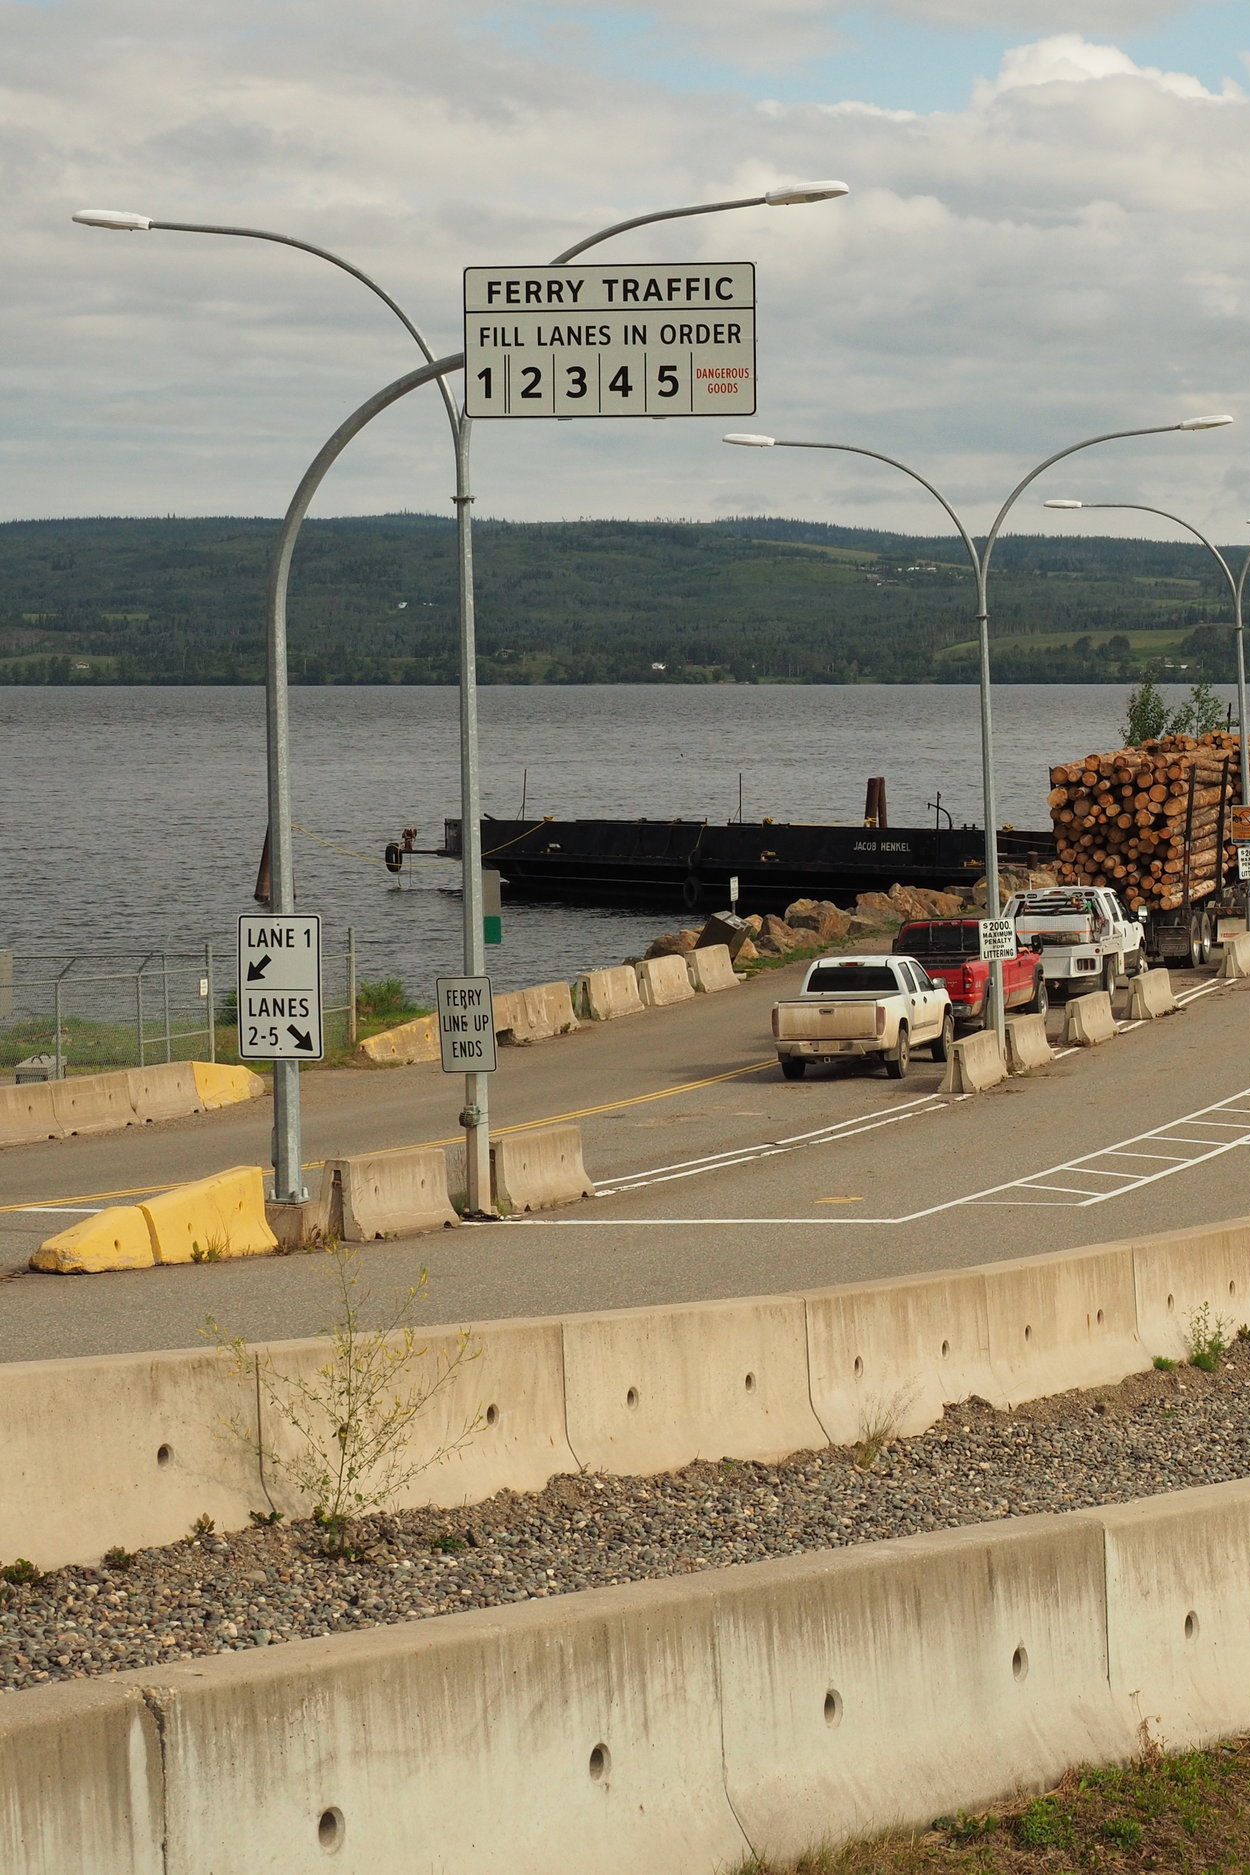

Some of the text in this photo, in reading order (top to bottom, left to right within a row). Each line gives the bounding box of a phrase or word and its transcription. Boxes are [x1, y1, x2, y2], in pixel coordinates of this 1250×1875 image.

[487, 276, 734, 304] FERRY TRAFFIC
[479, 323, 742, 347] FILL LANES IN ORDER
[477, 365, 679, 399] 1 2 3 4 5
[696, 367, 750, 380] DANGEROUS
[707, 382, 738, 395] GOODS
[853, 841, 911, 852] JACOB HENKEL
[247, 928, 311, 948] LANE 1
[983, 931, 1013, 939] MAXIMUM
[984, 937, 1012, 945] PENALTY
[983, 948, 1014, 959] LITTERING
[446, 988, 482, 1007] FERRY
[248, 997, 310, 1018] LANES
[443, 1014, 489, 1033] LINE UP
[248, 1026, 279, 1046] 2-5
[452, 1040, 483, 1058] ENDS
